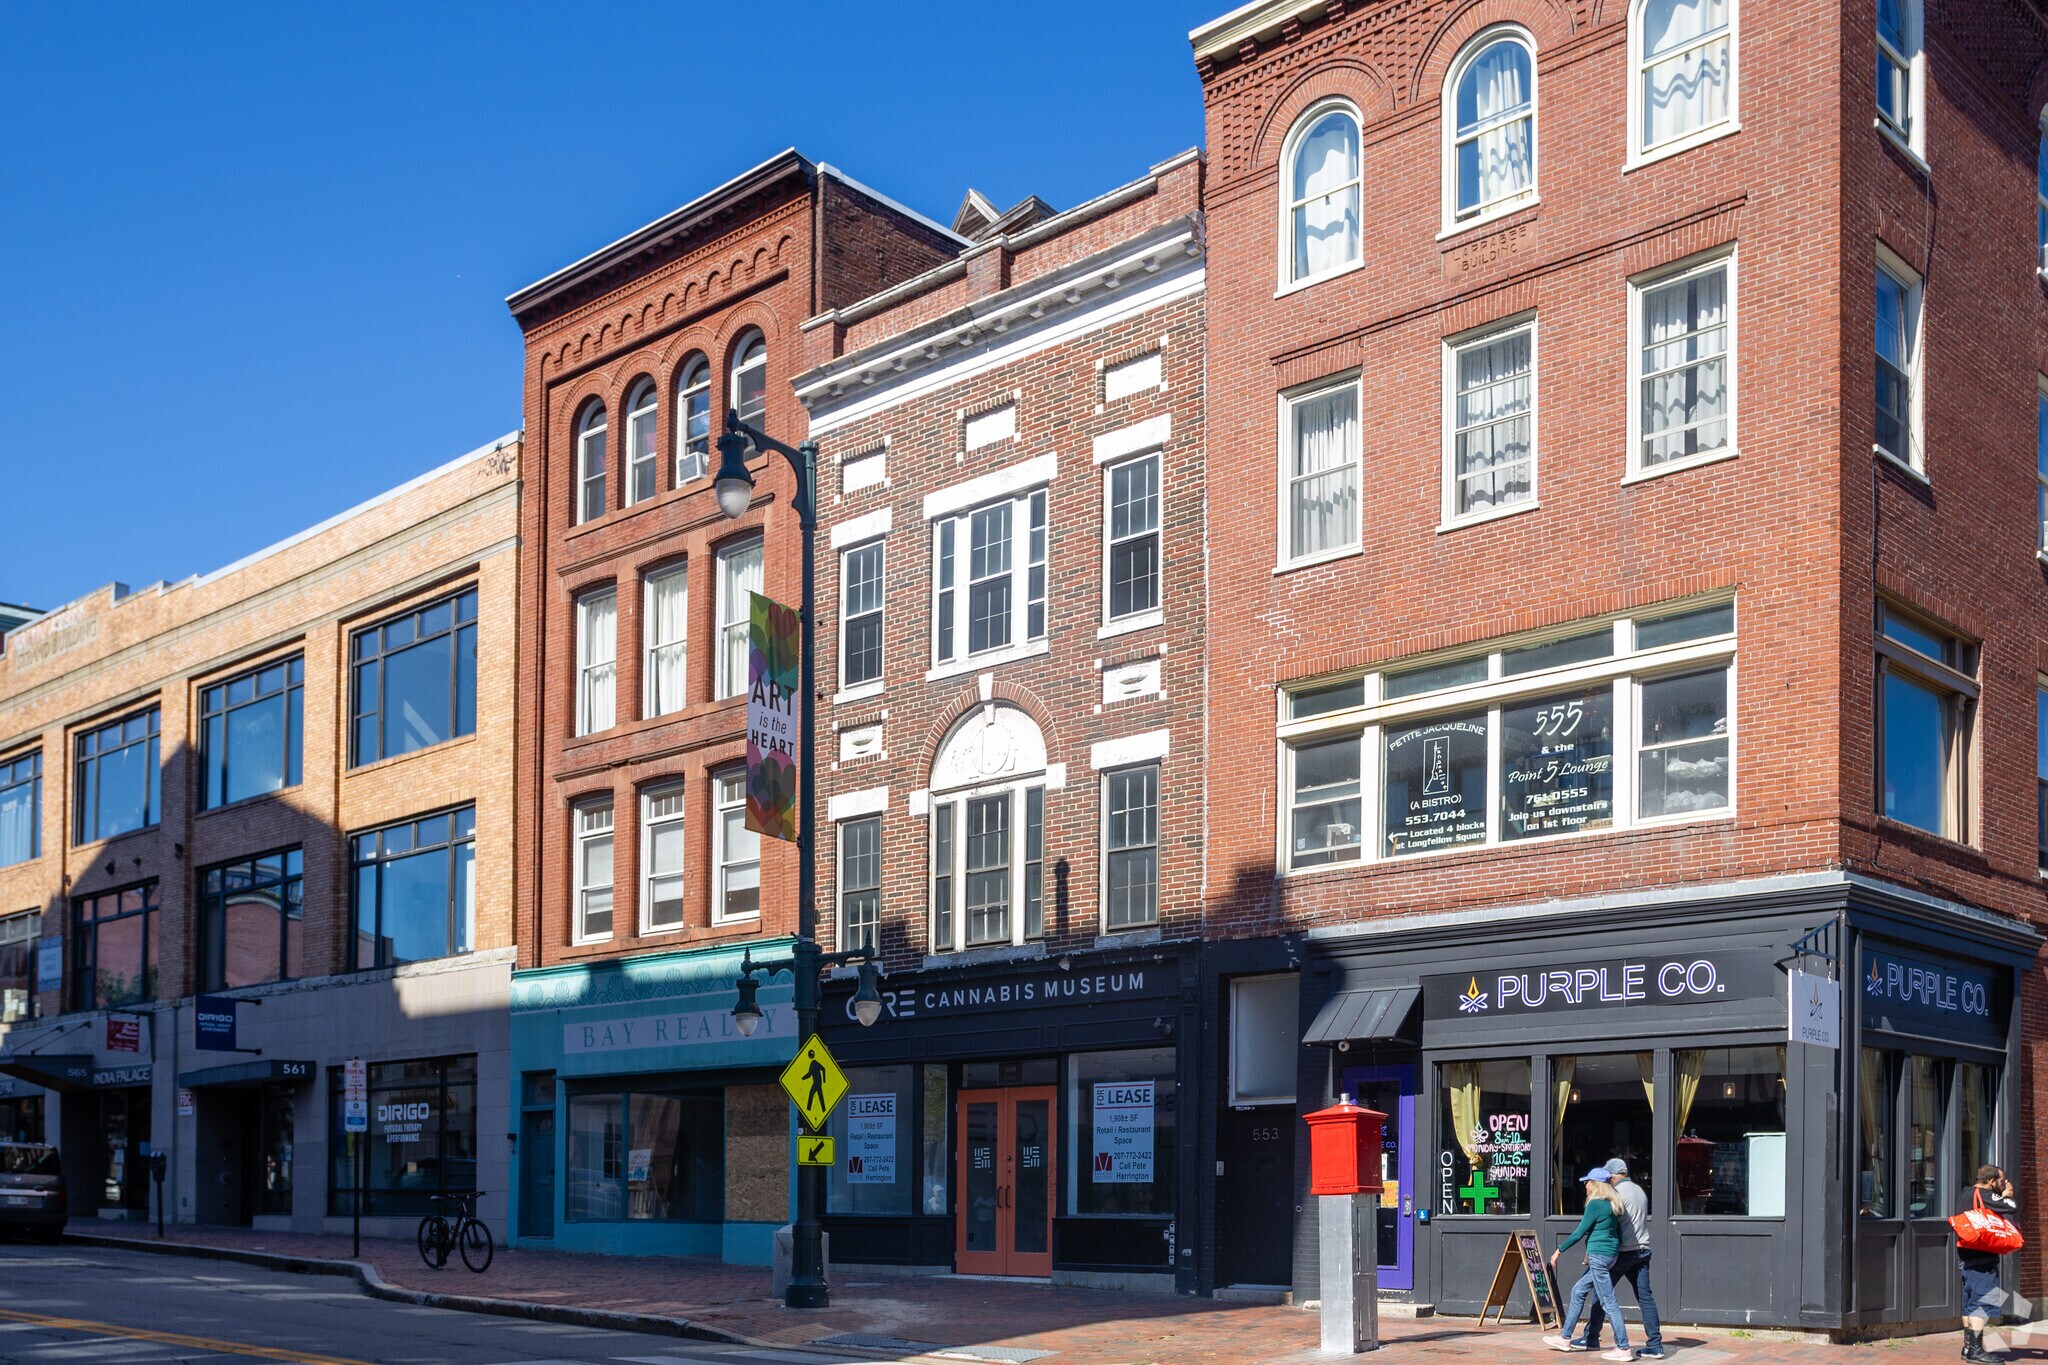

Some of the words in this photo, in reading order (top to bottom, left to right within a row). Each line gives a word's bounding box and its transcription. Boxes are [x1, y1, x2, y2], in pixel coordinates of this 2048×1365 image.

[1453, 226, 1527, 261] LARRABEE
[1462, 243, 1518, 271] BUILDING
[751, 675, 796, 716] ART
[759, 711, 769, 729] is
[771, 715, 787, 735] the
[1532, 699, 1584, 737] 555
[751, 728, 794, 757] HEART
[1389, 729, 1422, 751] PETITE
[1423, 722, 1486, 736] JACQUELINE
[1541, 745, 1550, 755] &
[1554, 743, 1575, 753] the
[1508, 767, 1544, 784] Point
[1543, 760, 1559, 784] 5
[1558, 760, 1609, 776] Lounge
[1410, 801, 1420, 811] (A
[1421, 793, 1462, 809] BISTRO)
[1405, 809, 1466, 826] 553.7044
[1508, 811, 1529, 822] Join
[1532, 810, 1546, 819] us
[1548, 801, 1608, 816] downstairs
[1526, 822, 1540, 831] on
[1543, 819, 1558, 829] 1st
[1561, 816, 1588, 827] floor
[1410, 826, 1444, 838] Located
[1395, 842, 1405, 850] at
[1407, 836, 1454, 848] Longfellow
[1456, 831, 1486, 843] Square
[1498, 965, 1645, 1009] PURPLE
[1657, 959, 1725, 997] CO.
[1887, 962, 1957, 1010] PURPLE
[1962, 981, 1989, 1017] CO.
[845, 990, 916, 1021] CRE
[925, 983, 1035, 1009] CANNABIS
[1044, 973, 1144, 999] MUSEUM
[197, 1013, 234, 1023] DIRIGO
[583, 1022, 635, 1049] BAY
[655, 1008, 777, 1042] REALY
[1802, 1026, 1821, 1041] PURPLE
[67, 1068, 88, 1078] 565
[116, 1067, 150, 1083] PALACE
[283, 1063, 306, 1075] 561
[1096, 1089, 1104, 1106] FOR
[1108, 1089, 1151, 1104] LEASE
[377, 1102, 430, 1122] DIRIGO
[849, 1100, 857, 1115] FOR
[859, 1099, 893, 1114] LEASE
[1129, 1114, 1138, 1122] SF
[1489, 1114, 1529, 1132] OPEN
[384, 1124, 404, 1133] PHYSICAL
[404, 1123, 422, 1132] THERAPY
[876, 1122, 883, 1130] SF
[1096, 1126, 1114, 1134] Retail
[1117, 1125, 1151, 1134] Restaurant
[867, 1132, 894, 1140] Restaurant
[1114, 1137, 1133, 1145] Space
[1253, 1127, 1279, 1141] 553
[863, 1142, 879, 1151] Space
[1385, 1141, 1398, 1149] CO.
[1113, 1151, 1152, 1160] 207-772-2422
[867, 1164, 878, 1172] Call
[879, 1164, 890, 1172] Pete
[1119, 1162, 1131, 1170] Call
[1132, 1162, 1147, 1170] Pete
[1490, 1165, 1528, 1178] SUNDAY
[865, 1174, 892, 1182] Harrington
[1116, 1172, 1149, 1182] Harrington
[1440, 1151, 1454, 1215] OPEN
